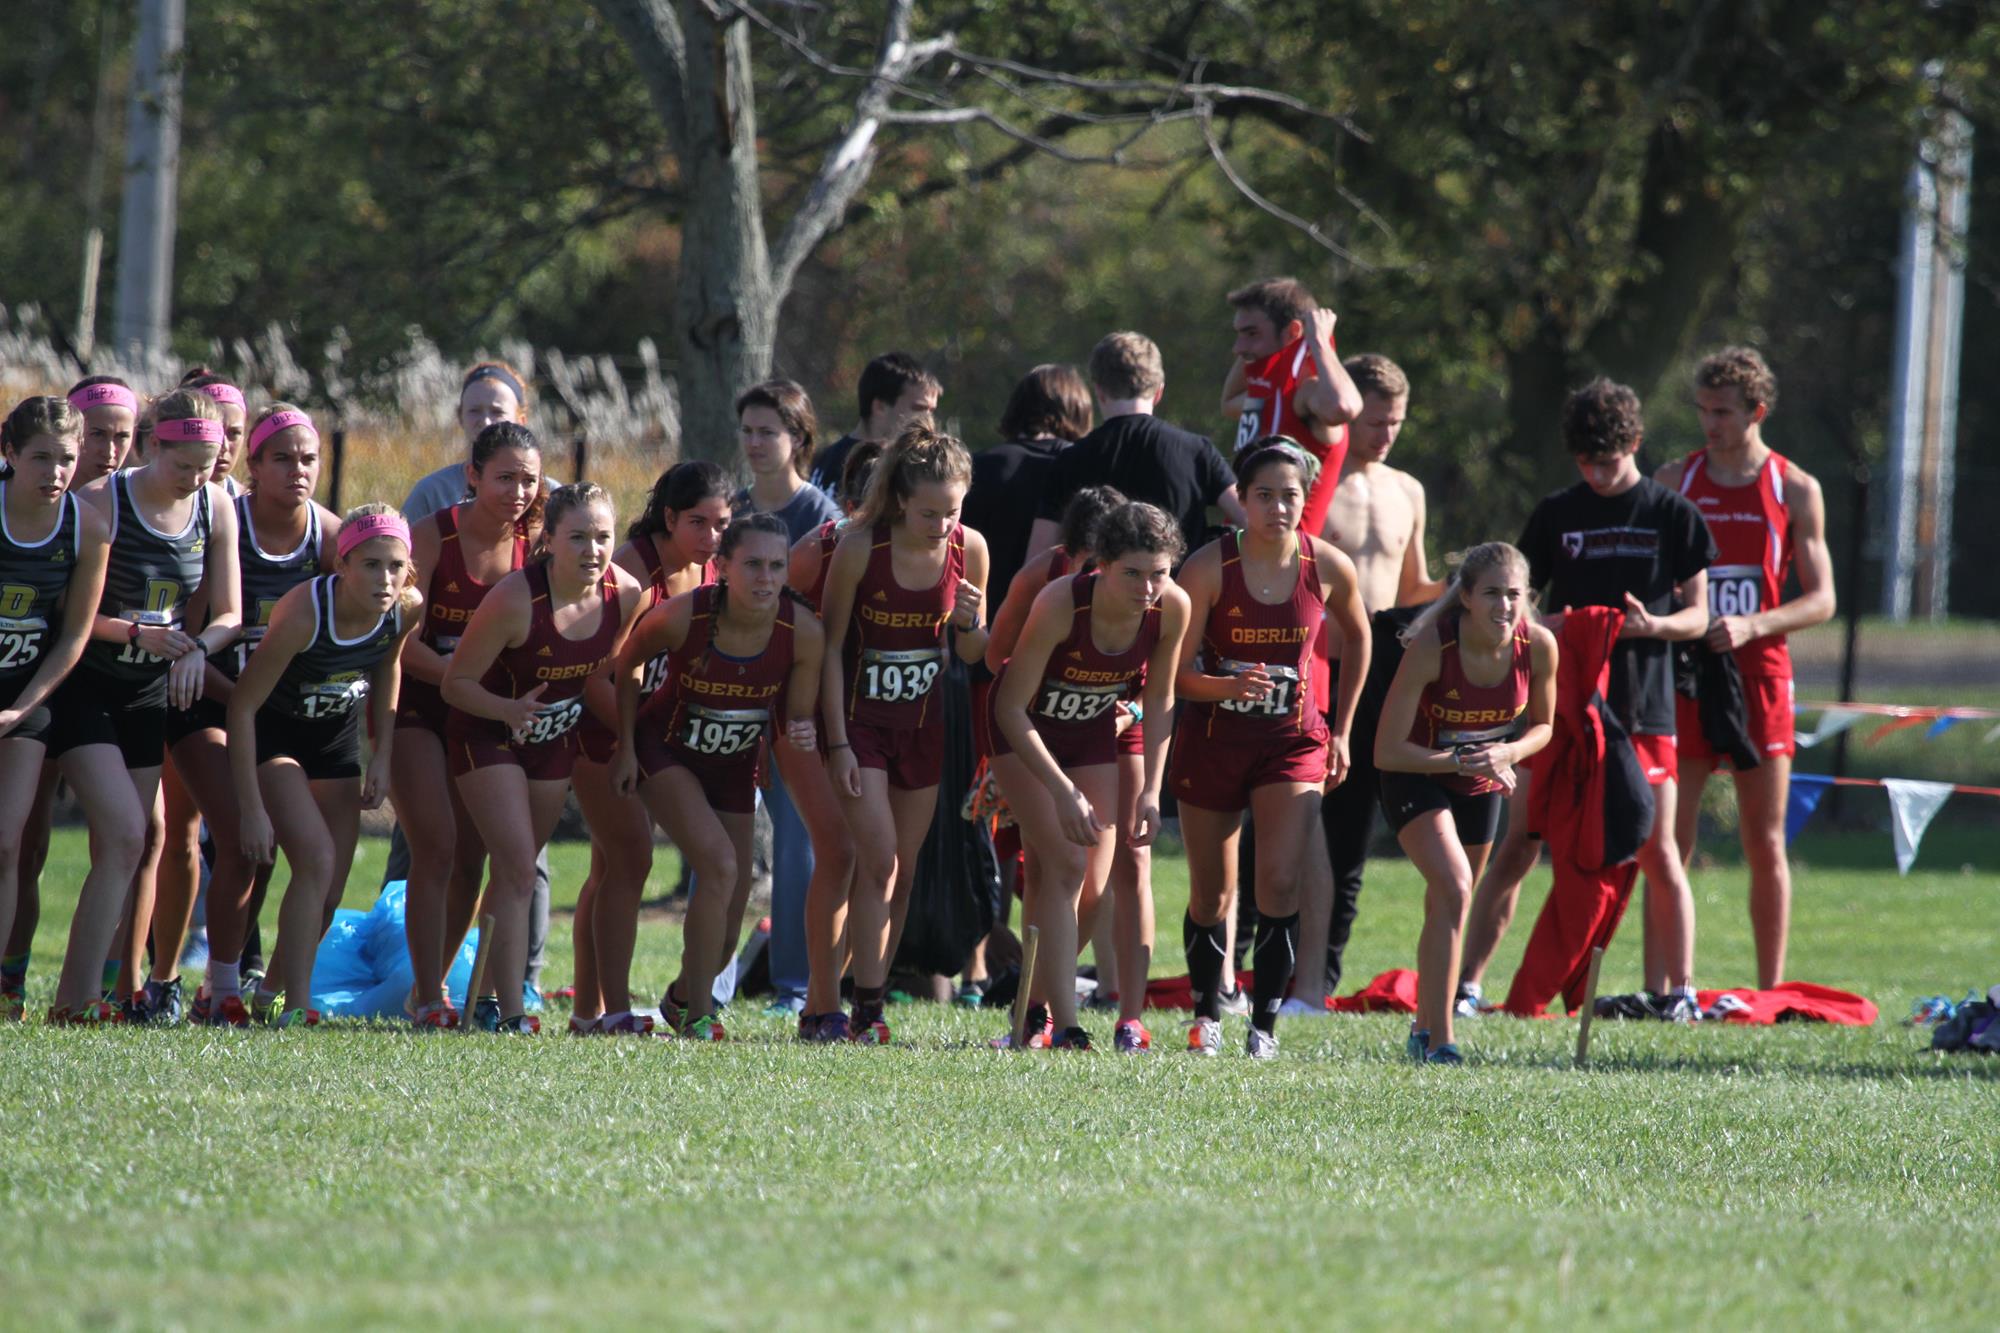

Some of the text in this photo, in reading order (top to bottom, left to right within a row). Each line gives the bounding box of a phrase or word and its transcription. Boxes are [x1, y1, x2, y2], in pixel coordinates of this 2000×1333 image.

[1708, 579, 1759, 617] 160
[0, 632, 42, 669] 25
[1232, 626, 1309, 643] OBERLIN
[680, 672, 782, 699] OBERLIN
[865, 661, 939, 702] 1938
[684, 719, 761, 755] 1952
